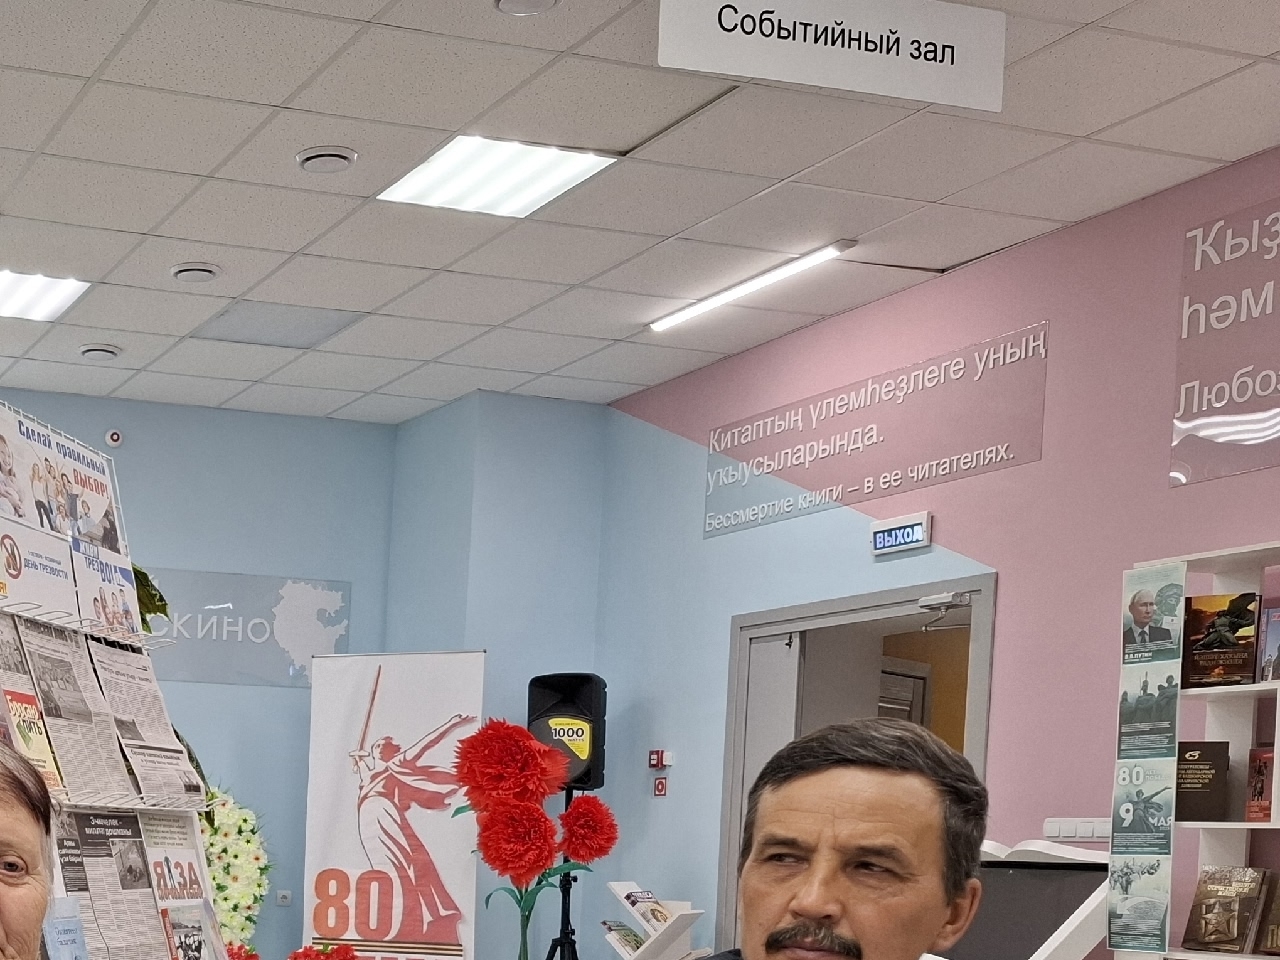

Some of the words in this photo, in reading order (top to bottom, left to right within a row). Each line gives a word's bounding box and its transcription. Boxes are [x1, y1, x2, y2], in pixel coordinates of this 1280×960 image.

[718, 3, 901, 57] Событийный
[909, 38, 956, 65] зал
[1181, 280, 1275, 340] һәм
[708, 408, 803, 454] Китаптың
[809, 356, 966, 430] үлемһеҙлеге
[974, 330, 1047, 383] уның
[1174, 365, 1280, 418] Любо
[18, 419, 53, 451] Сделай
[56, 441, 106, 477] правильный
[73, 468, 109, 499] ВЫБОР!
[705, 498, 793, 532] Бессмертие
[797, 481, 843, 511] книги
[863, 477, 875, 493] в
[880, 467, 902, 490] ее
[908, 442, 1015, 483] читателях.
[875, 523, 923, 549] ВЫХОД
[24, 558, 39, 571] ДЕНЬ
[39, 563, 68, 580] ТРЕЗВОСТИ
[552, 727, 585, 738] 1000
[1118, 767, 1144, 785] 80
[1119, 802, 1133, 827] 9
[312, 868, 395, 941] 80
